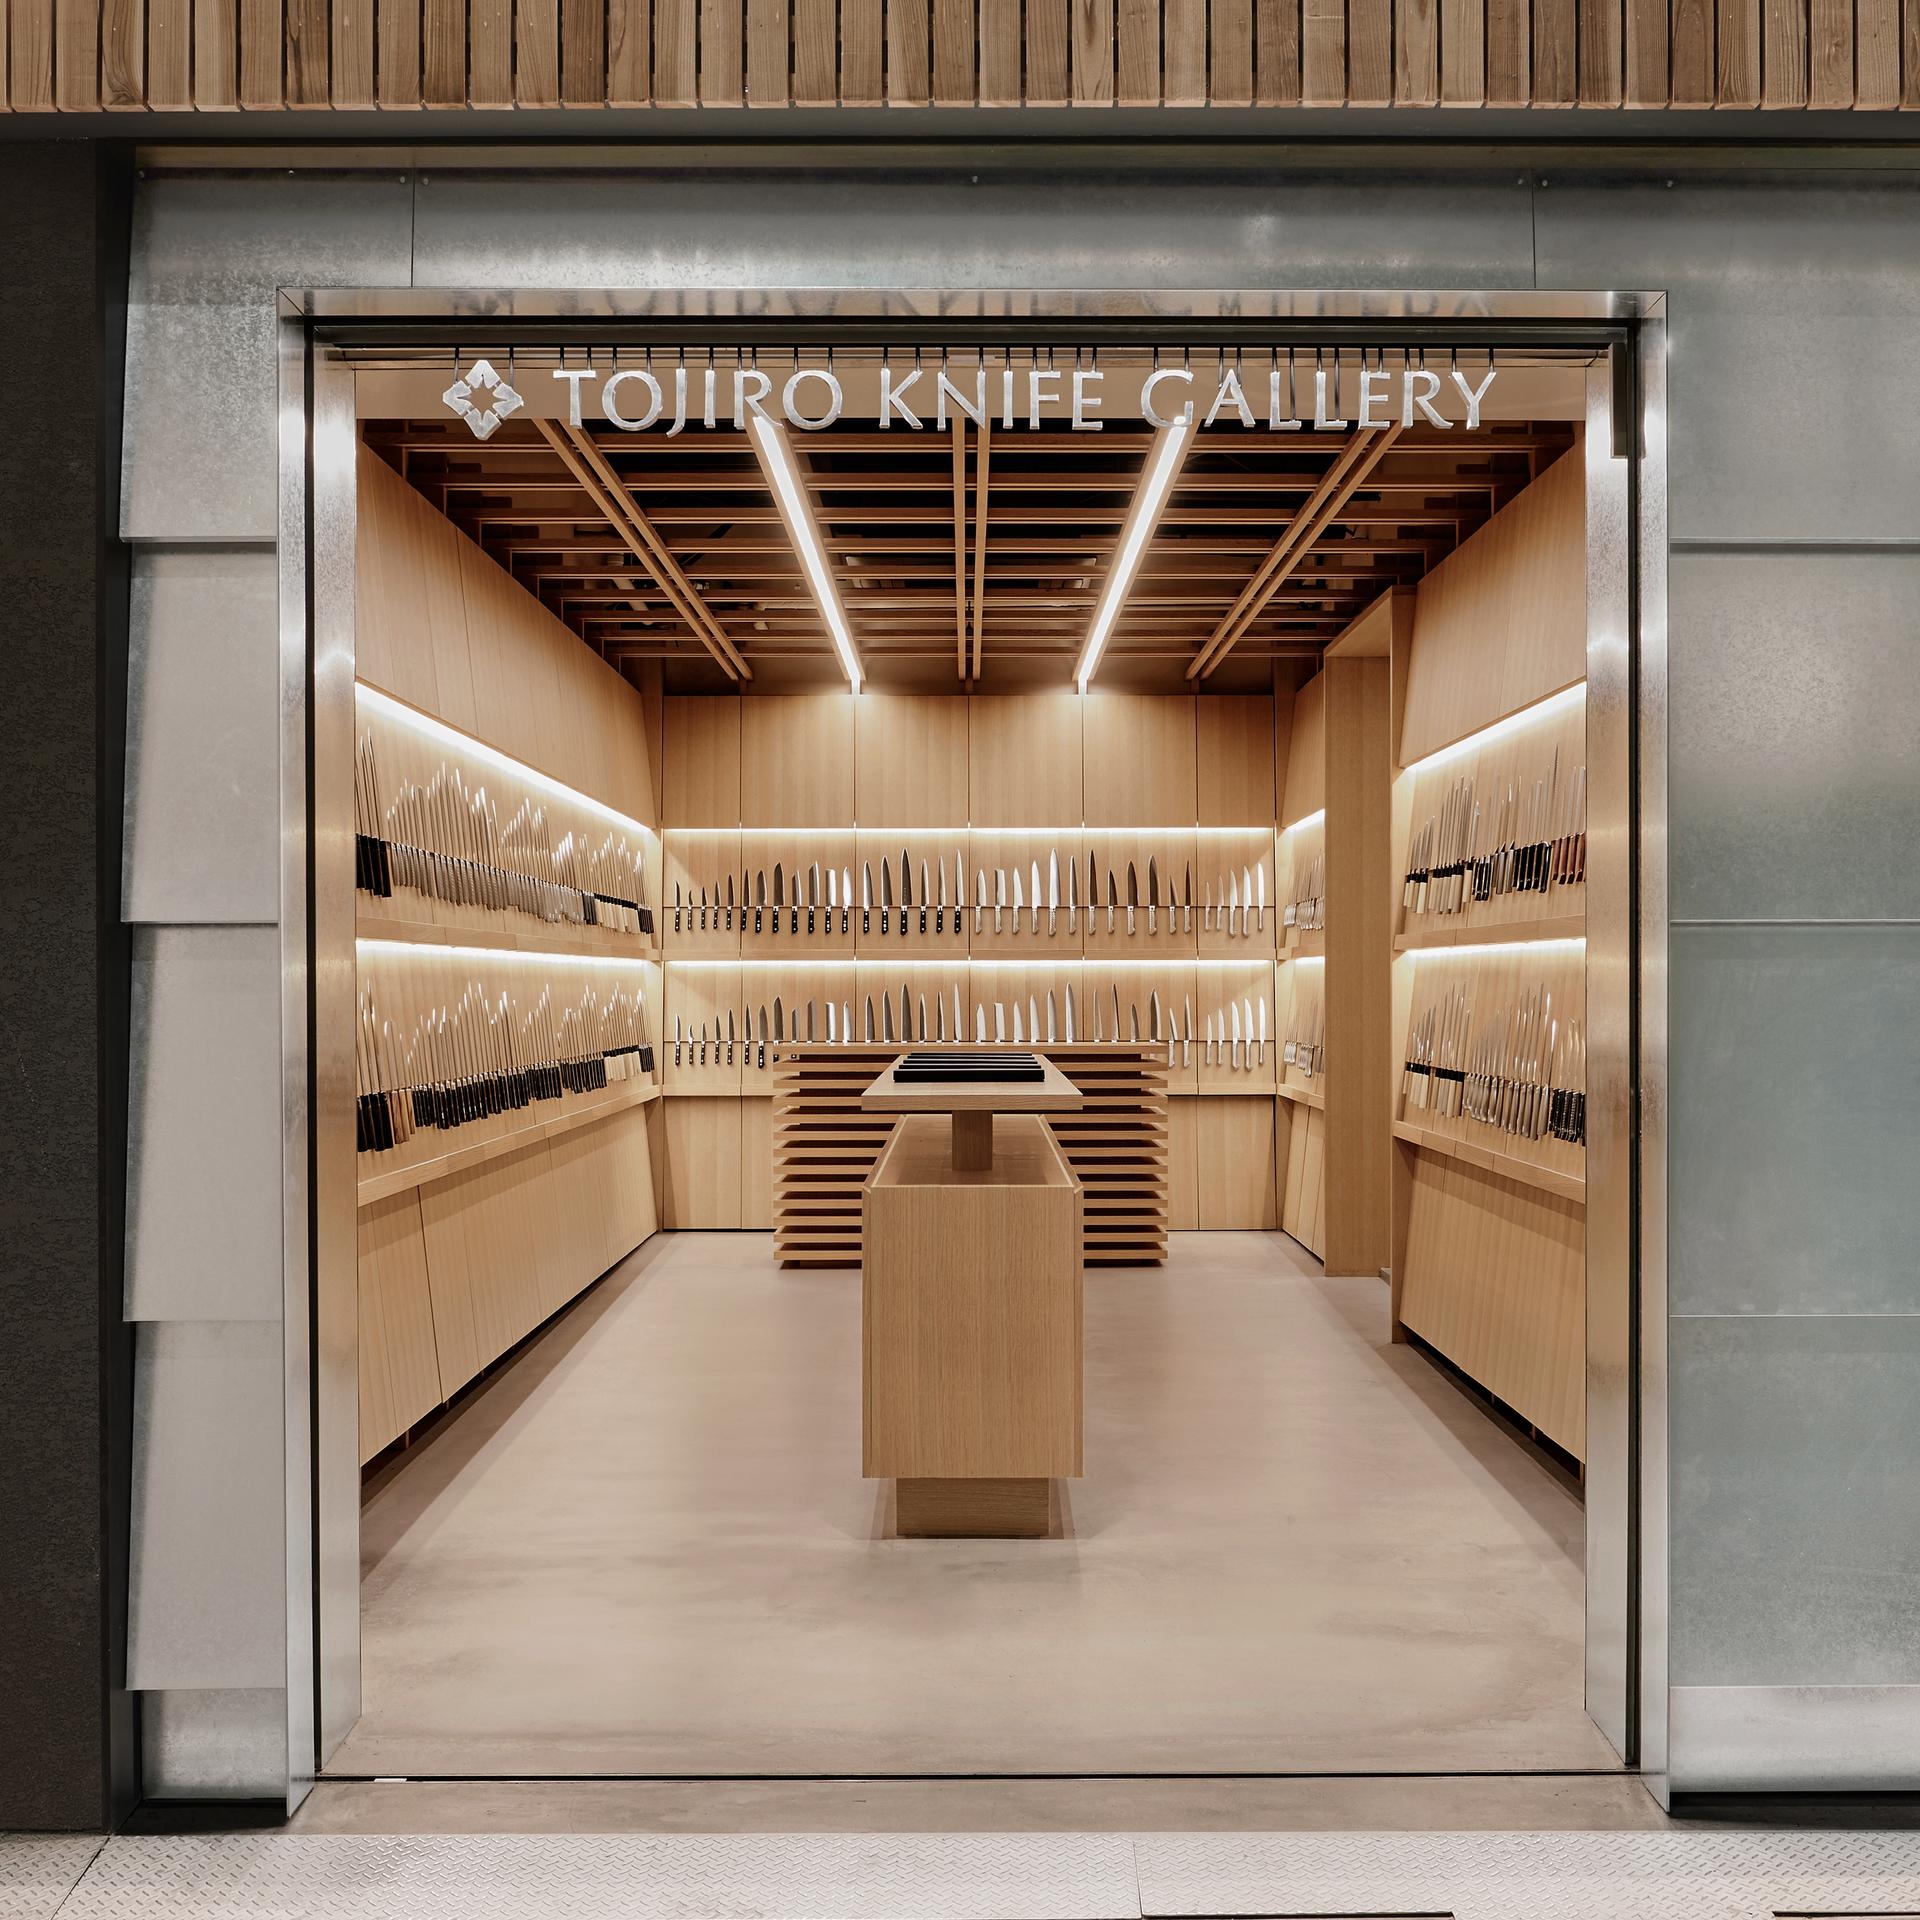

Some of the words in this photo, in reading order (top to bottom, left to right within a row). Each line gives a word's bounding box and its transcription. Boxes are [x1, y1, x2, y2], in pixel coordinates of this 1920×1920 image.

[552, 367, 844, 438] TOJIRO
[880, 367, 1104, 431] KNIFE
[1140, 368, 1497, 431] GALLERY
